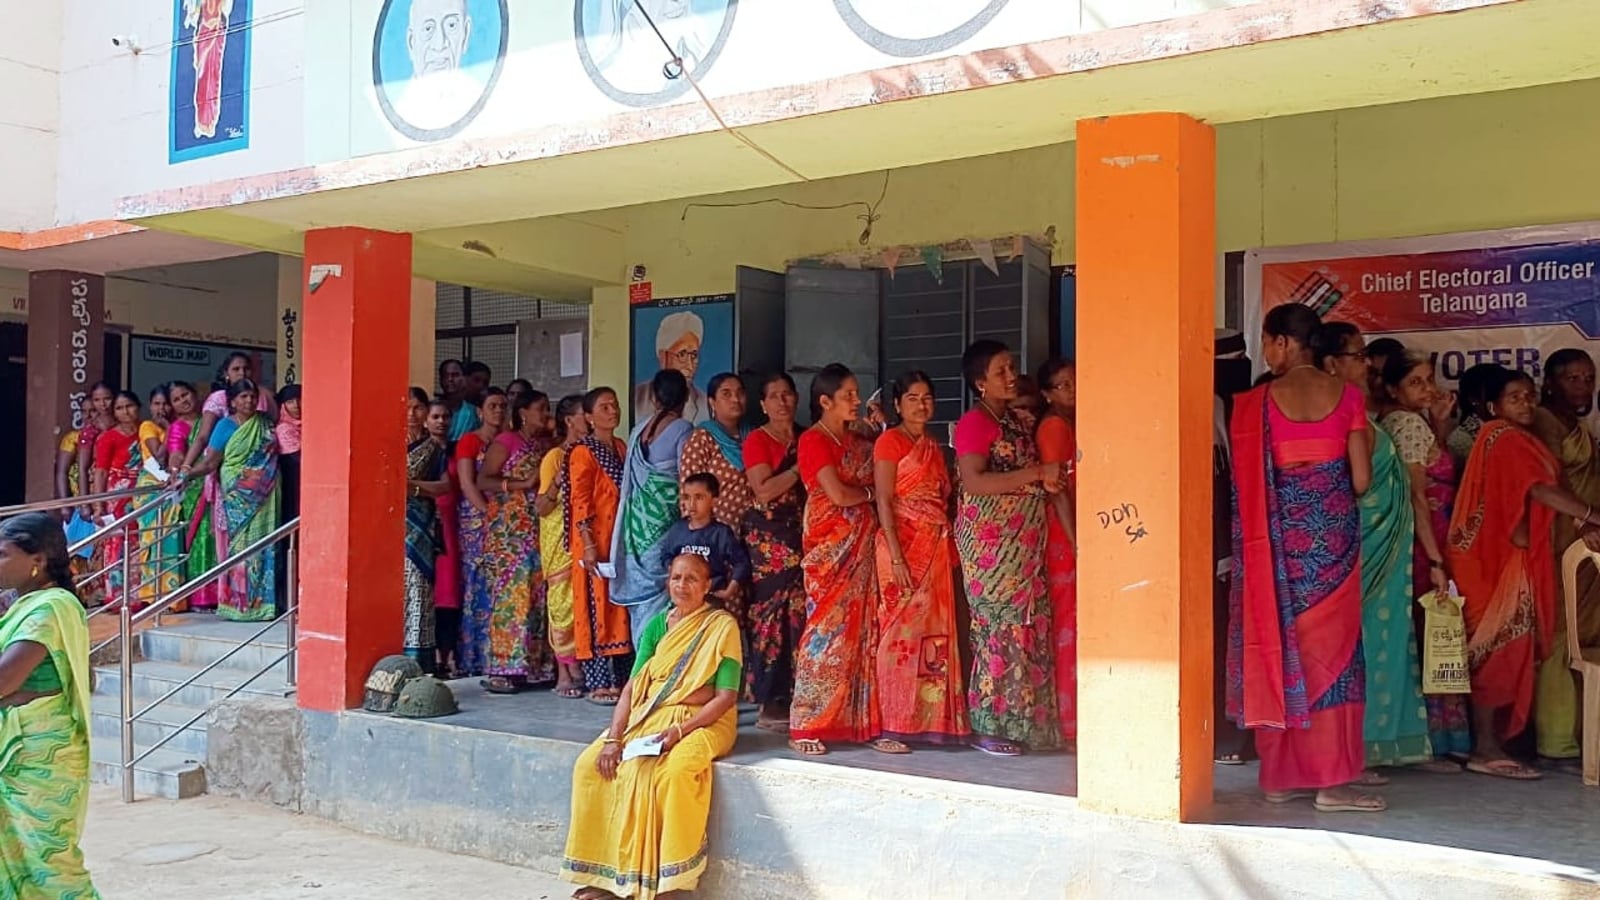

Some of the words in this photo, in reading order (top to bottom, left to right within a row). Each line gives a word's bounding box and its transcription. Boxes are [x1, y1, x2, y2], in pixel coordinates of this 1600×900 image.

[1361, 271, 1412, 293] Chief
[1419, 265, 1511, 289] Electoral
[1520, 261, 1595, 283] Officer
[1420, 291, 1527, 315] Telangana
[148, 346, 183, 359] WORLD
[187, 349, 208, 361] MAP
